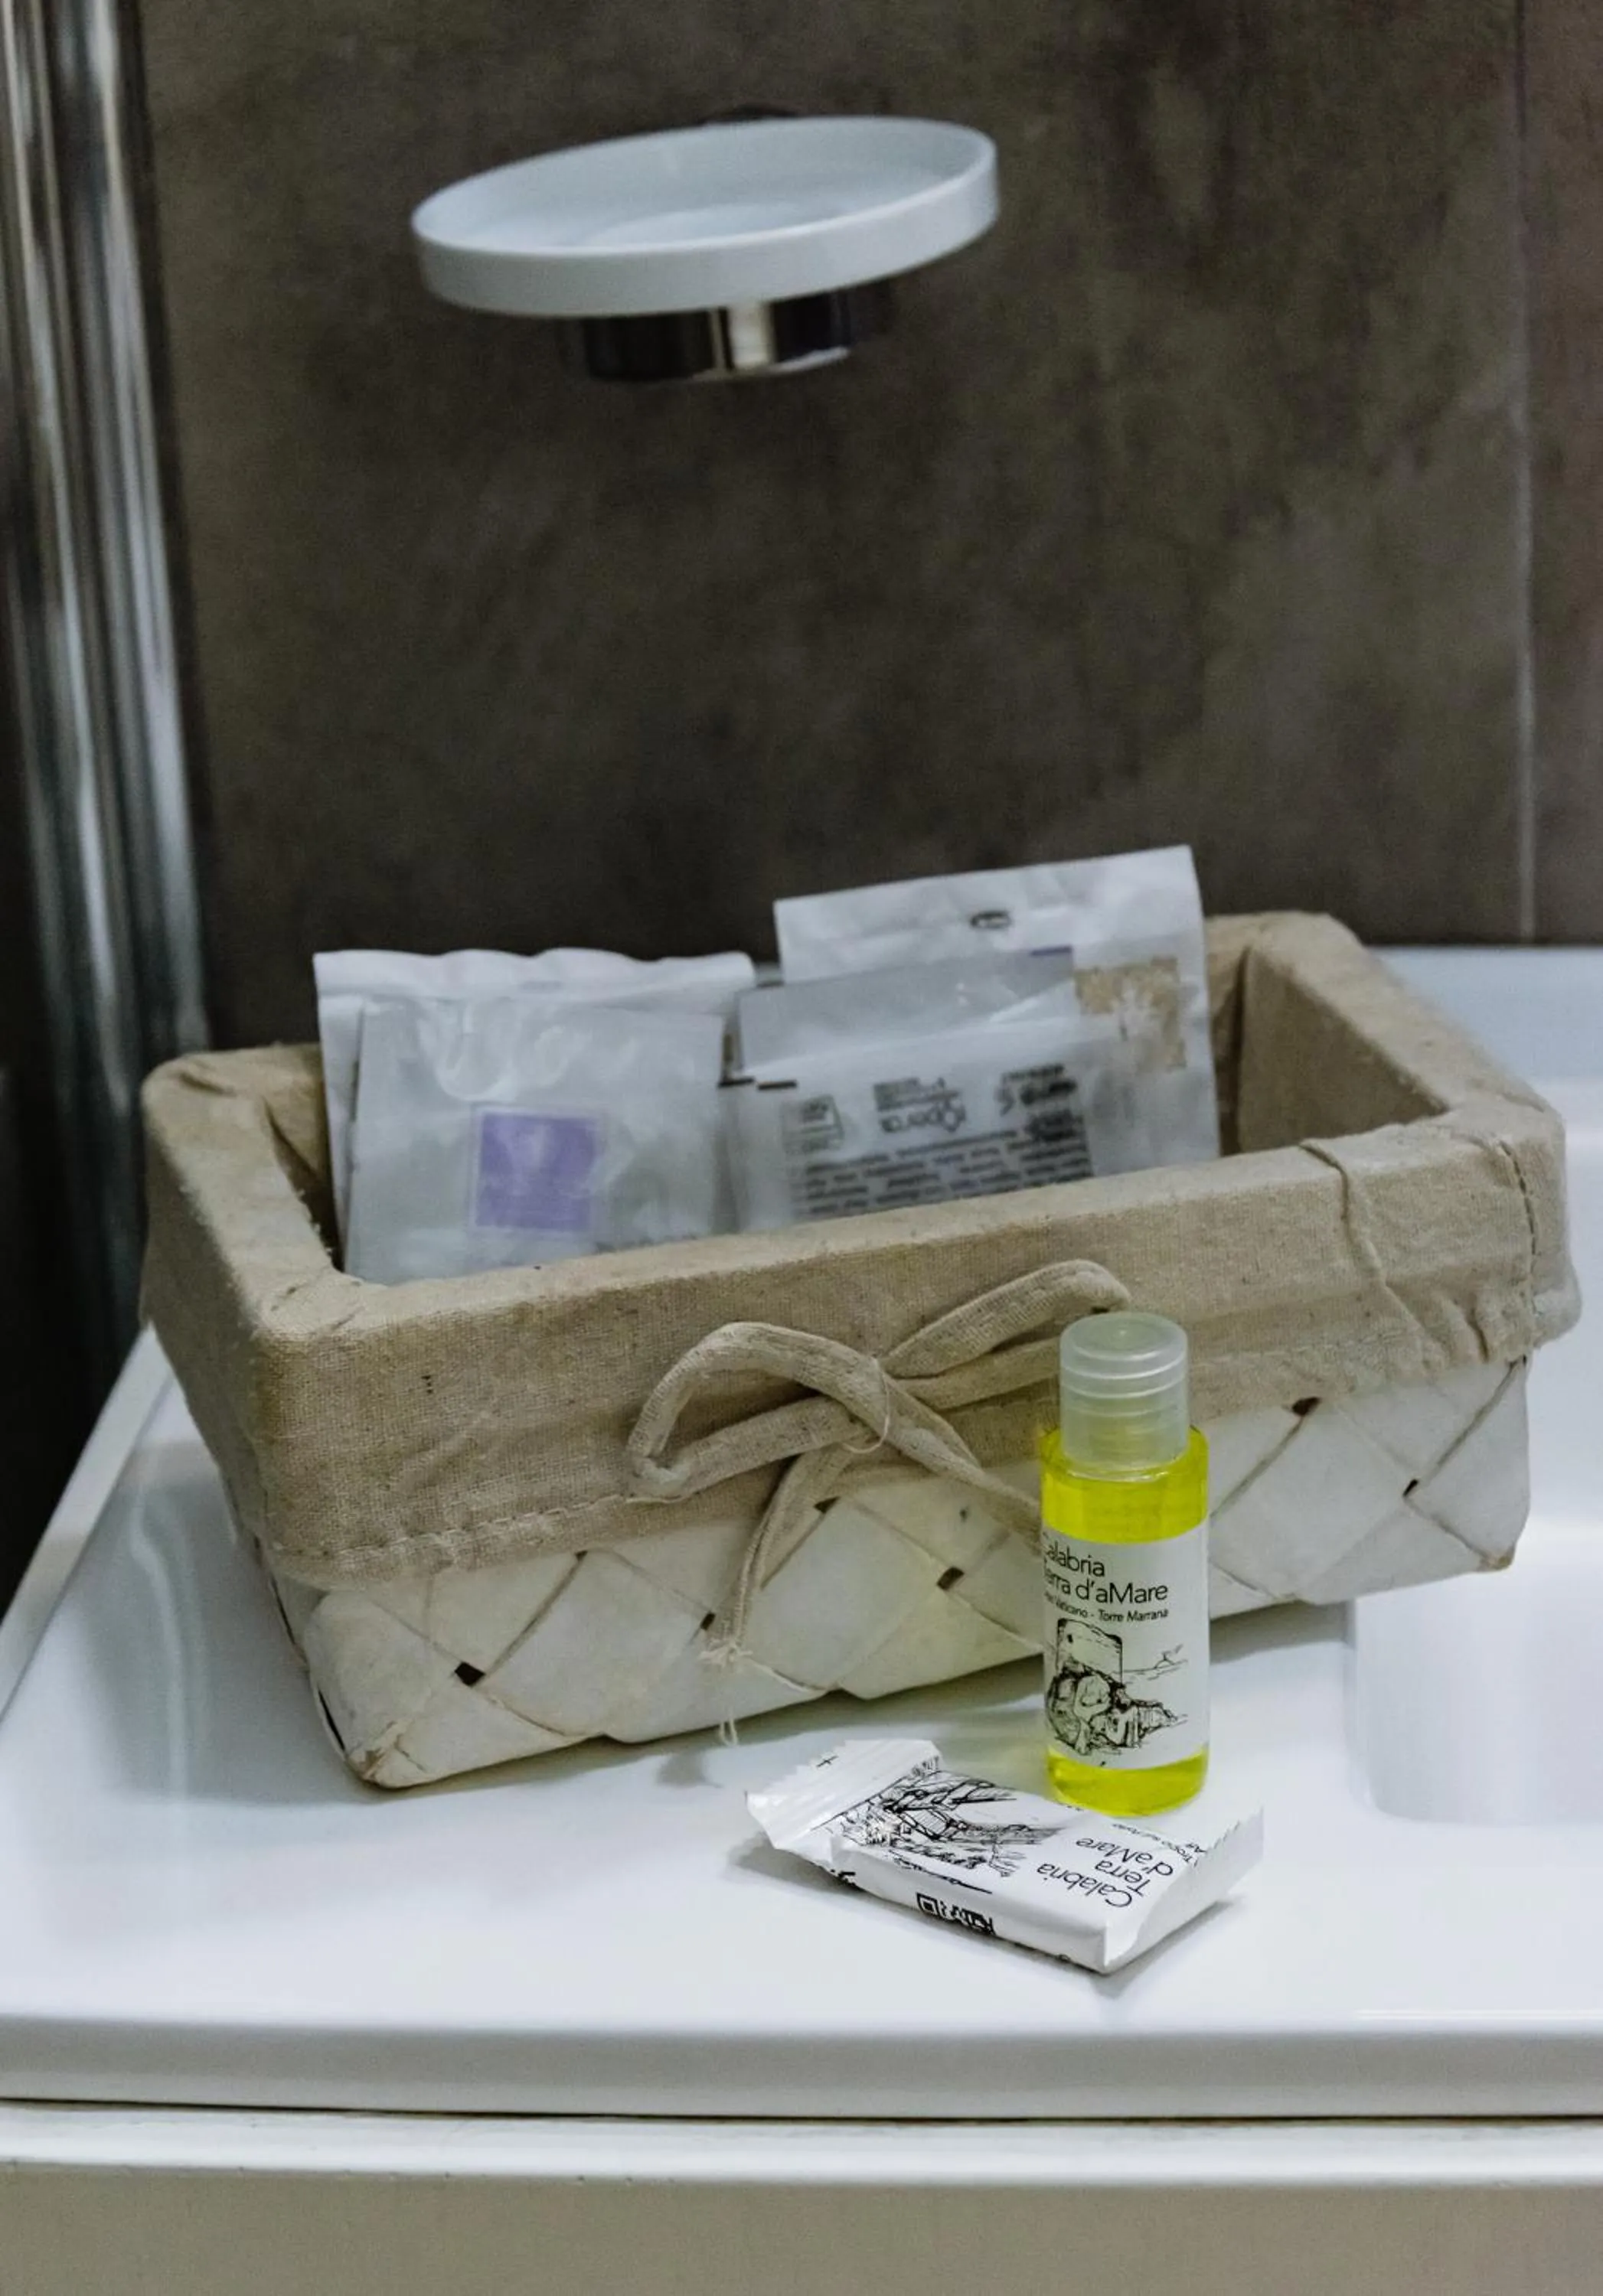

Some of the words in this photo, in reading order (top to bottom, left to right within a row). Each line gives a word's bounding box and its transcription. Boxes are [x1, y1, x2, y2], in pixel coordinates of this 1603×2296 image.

[1043, 1533, 1105, 1577] alabria
[1075, 1577, 1168, 1604] d'aMare
[1098, 1608, 1124, 1622] Torre
[1076, 1838, 1174, 1877] d'aMare
[1037, 1863, 1132, 1907] Calabria
[1095, 1860, 1151, 1896] Terra
